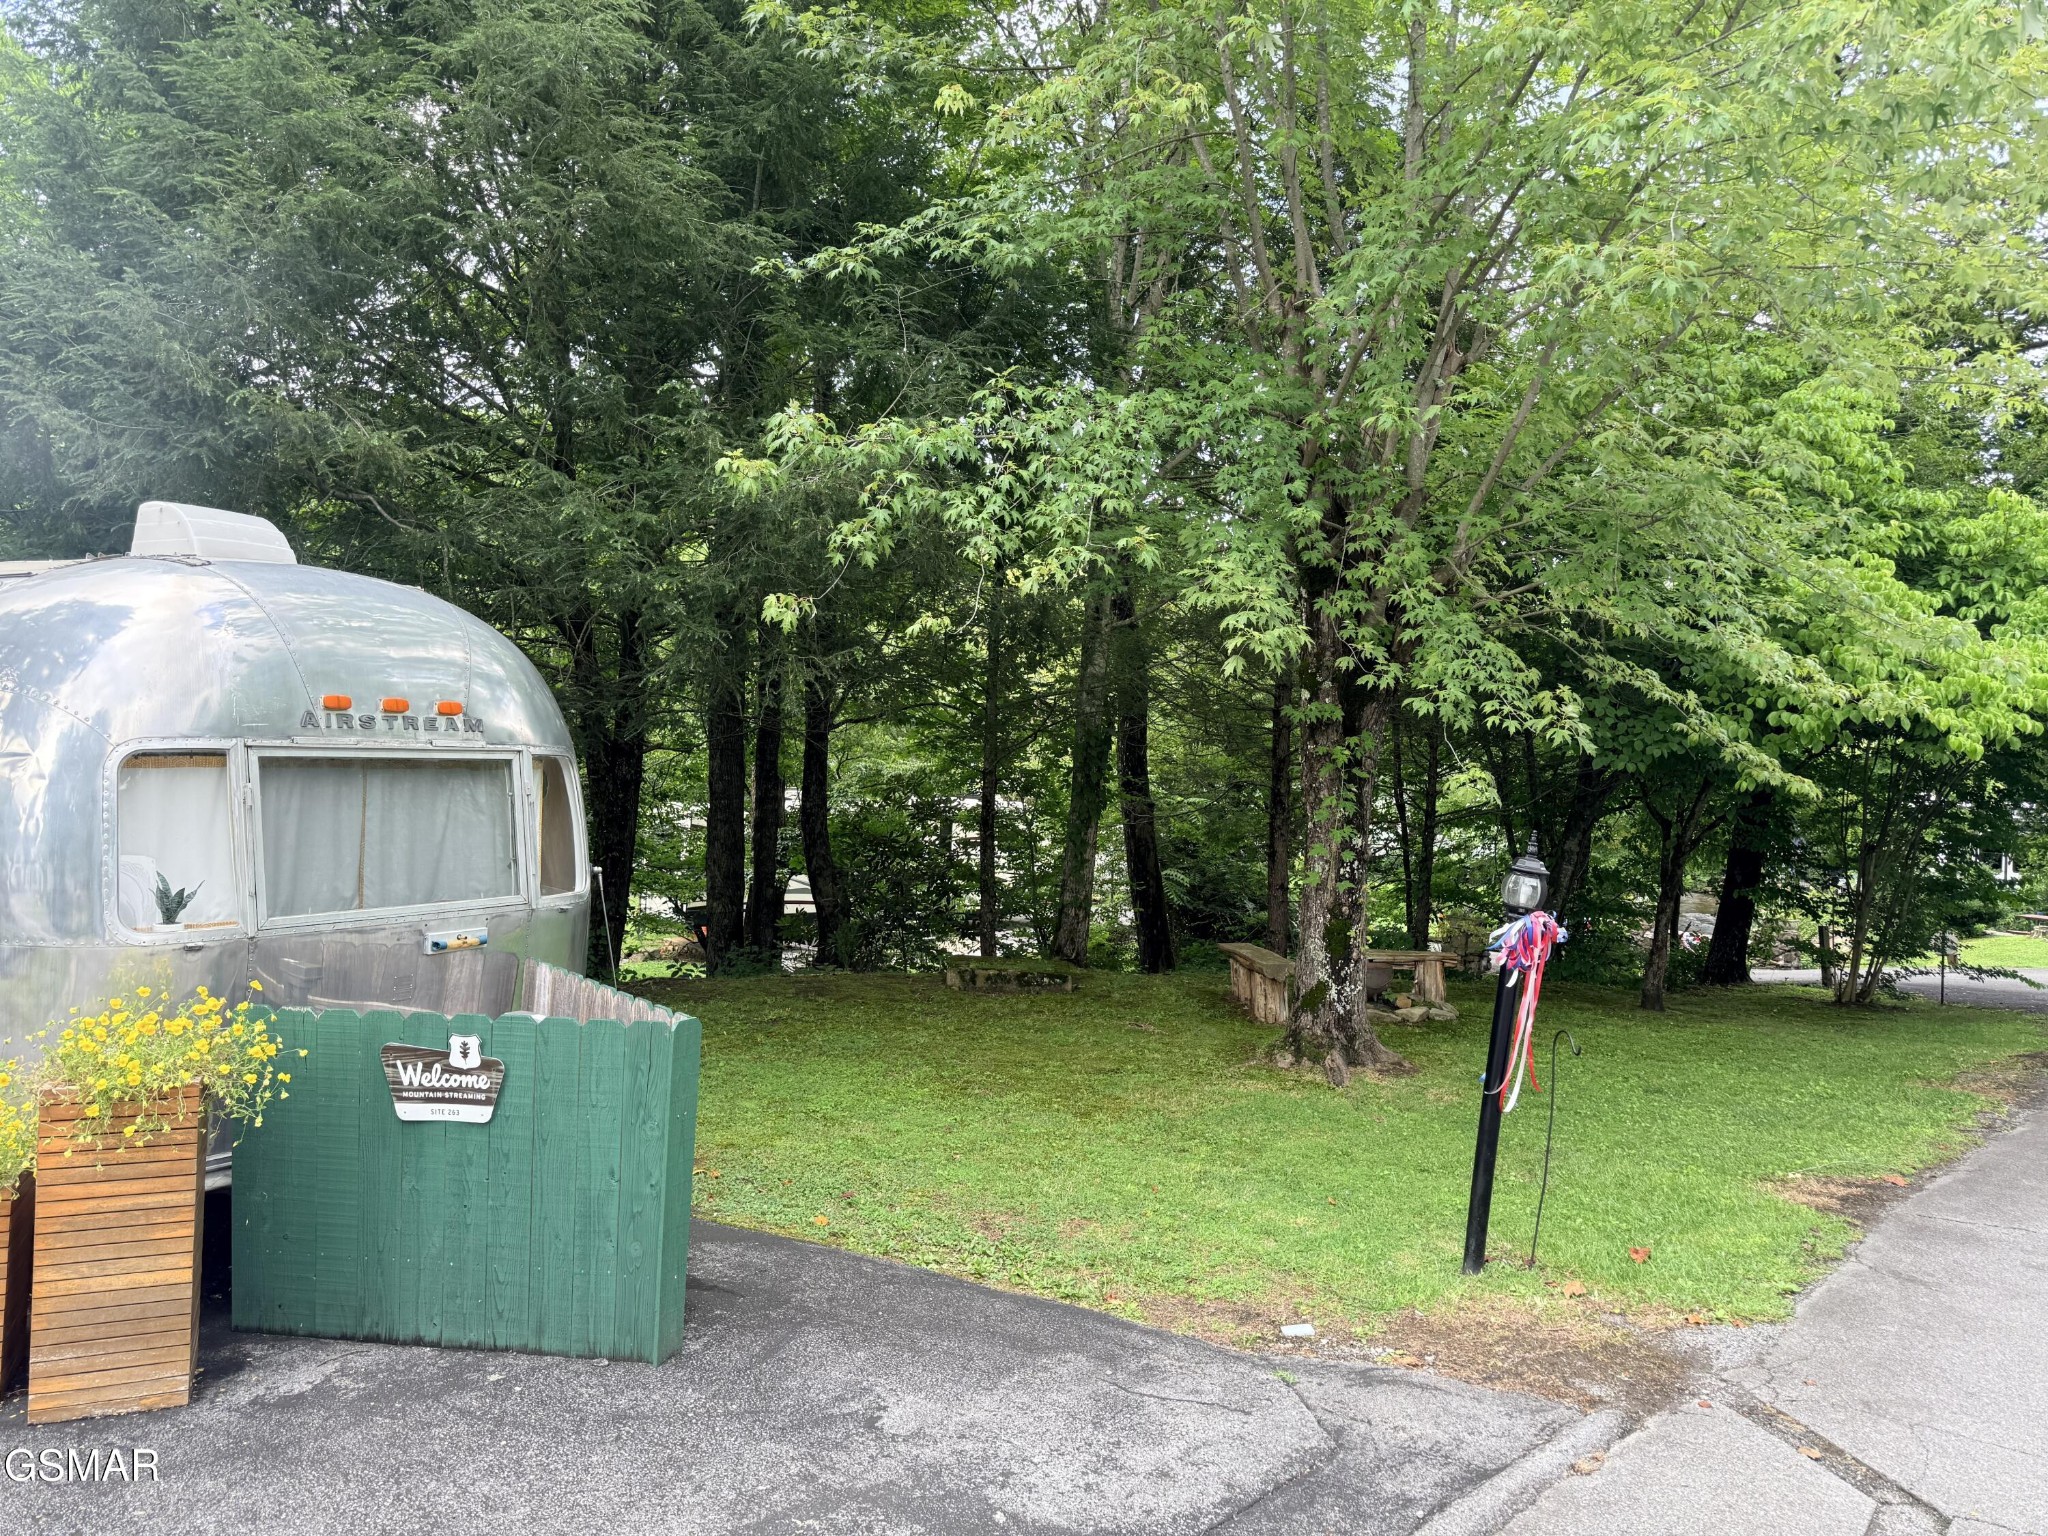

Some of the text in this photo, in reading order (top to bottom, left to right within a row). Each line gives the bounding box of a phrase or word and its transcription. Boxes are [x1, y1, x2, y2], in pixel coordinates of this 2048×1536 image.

[301, 711, 484, 733] AIRSTREAM
[396, 1060, 491, 1090] Welcome
[402, 1091, 486, 1101] MOUNTAIN STREAMING
[430, 1108, 460, 1116] SITE 263
